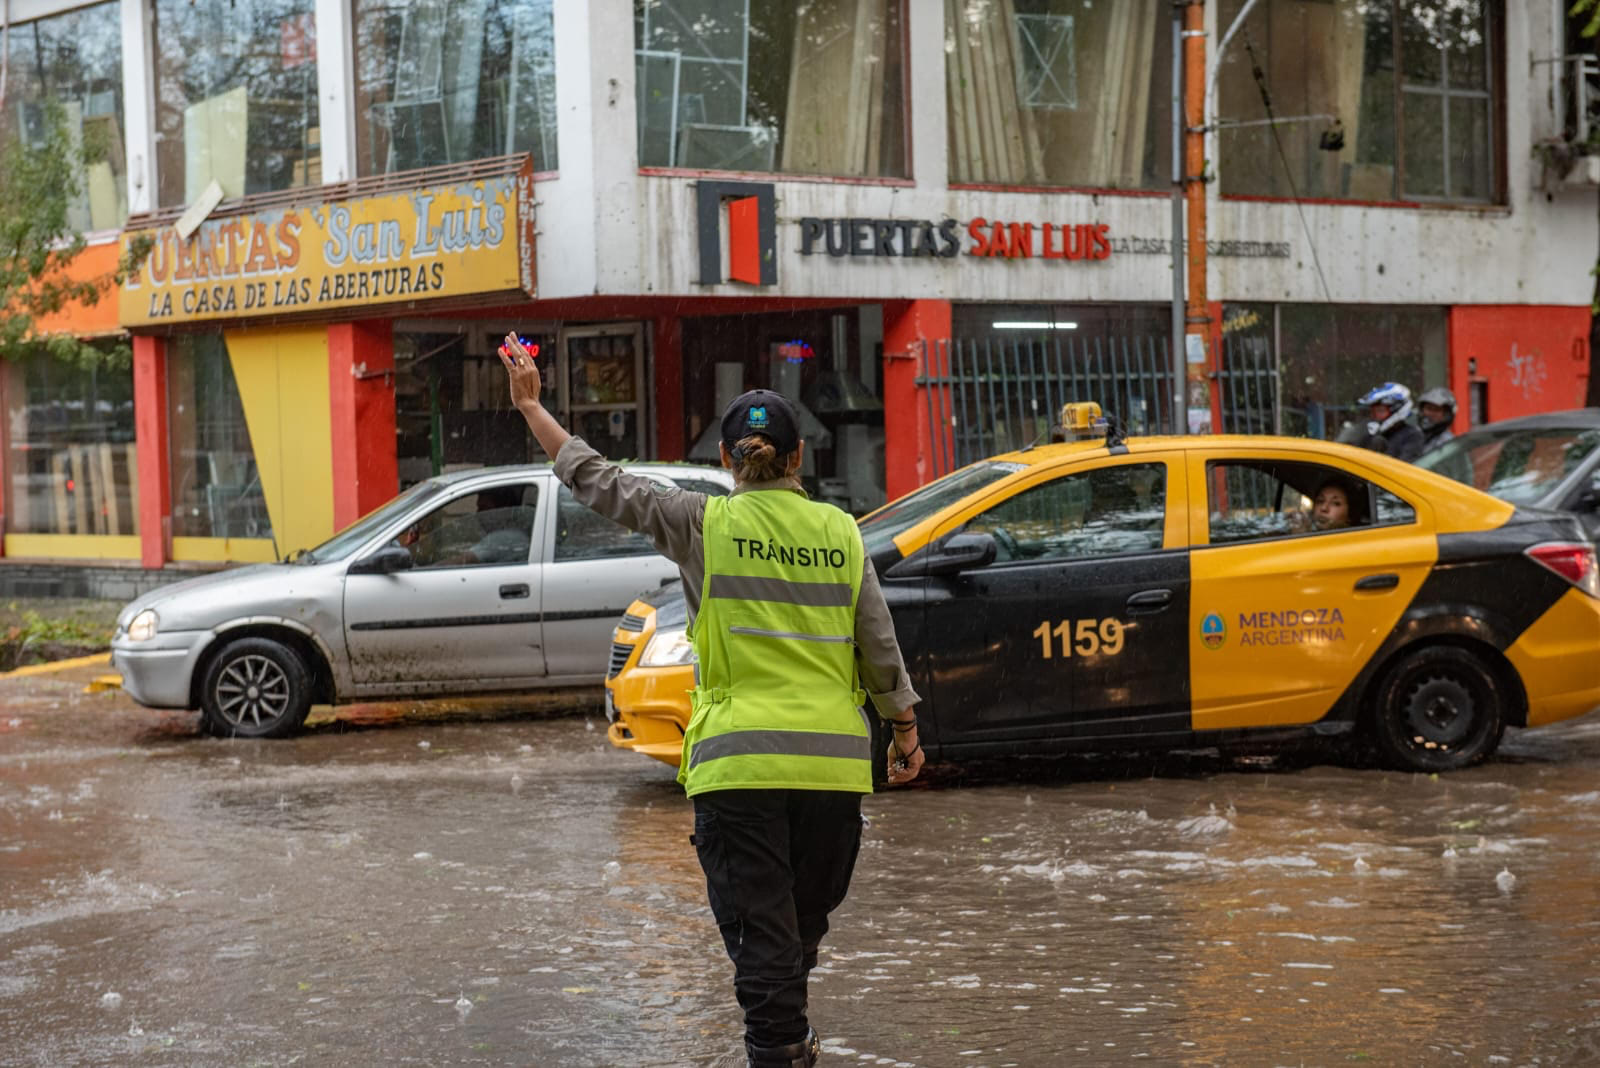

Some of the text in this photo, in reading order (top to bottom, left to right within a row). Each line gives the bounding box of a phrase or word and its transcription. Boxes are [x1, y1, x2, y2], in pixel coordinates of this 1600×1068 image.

[801, 217, 961, 258] PUERTAS
[967, 216, 1033, 258] SAN
[1042, 222, 1112, 261] LUIS
[148, 262, 445, 318] LA CASA DE LAS ABERTURAS
[732, 536, 846, 569] TRÁNSITO
[1032, 616, 1126, 660] 1159
[1239, 608, 1345, 630] MENDOZA
[1239, 627, 1346, 647] ARGENTINA
